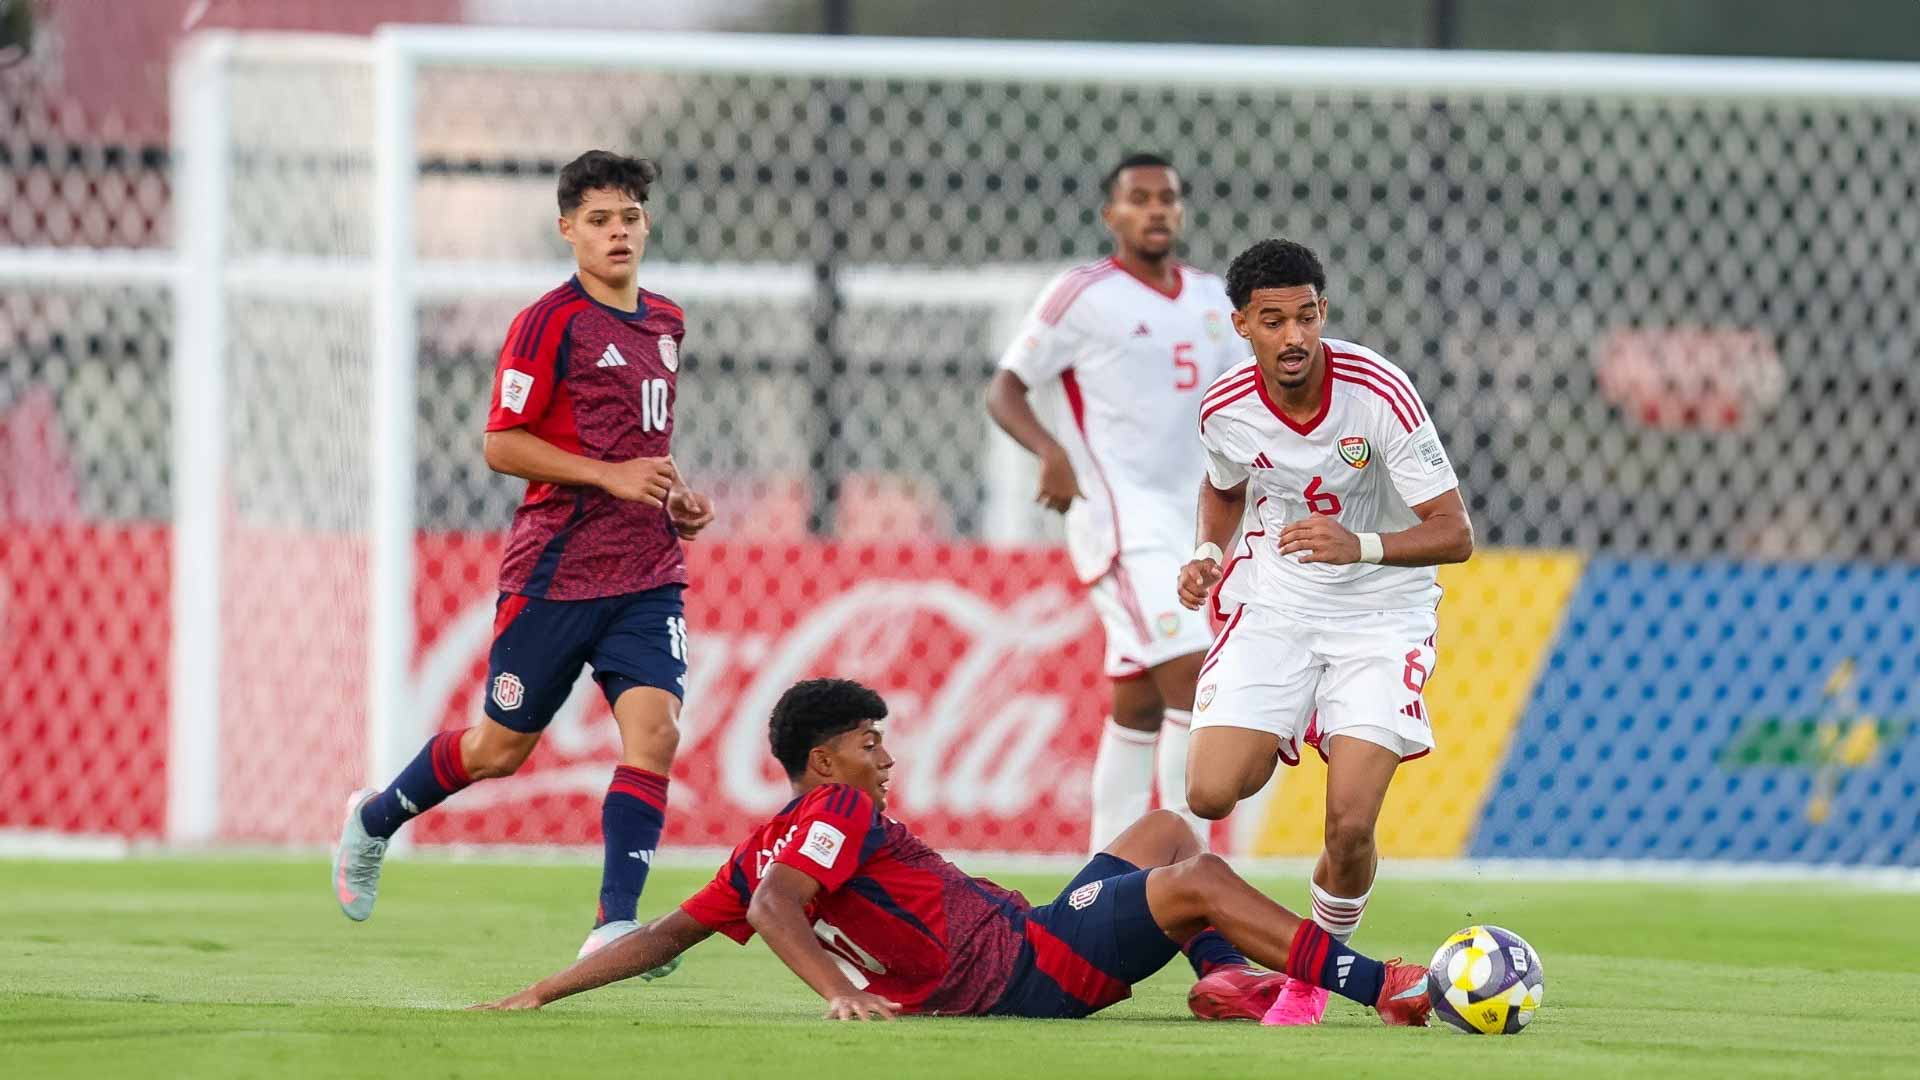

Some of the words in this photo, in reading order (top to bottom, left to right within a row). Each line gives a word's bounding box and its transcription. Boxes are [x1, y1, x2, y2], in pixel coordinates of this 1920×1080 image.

[1173, 342, 1200, 392] 5
[641, 378, 669, 432] 10
[1303, 475, 1342, 516] 6
[1403, 648, 1427, 694] 6
